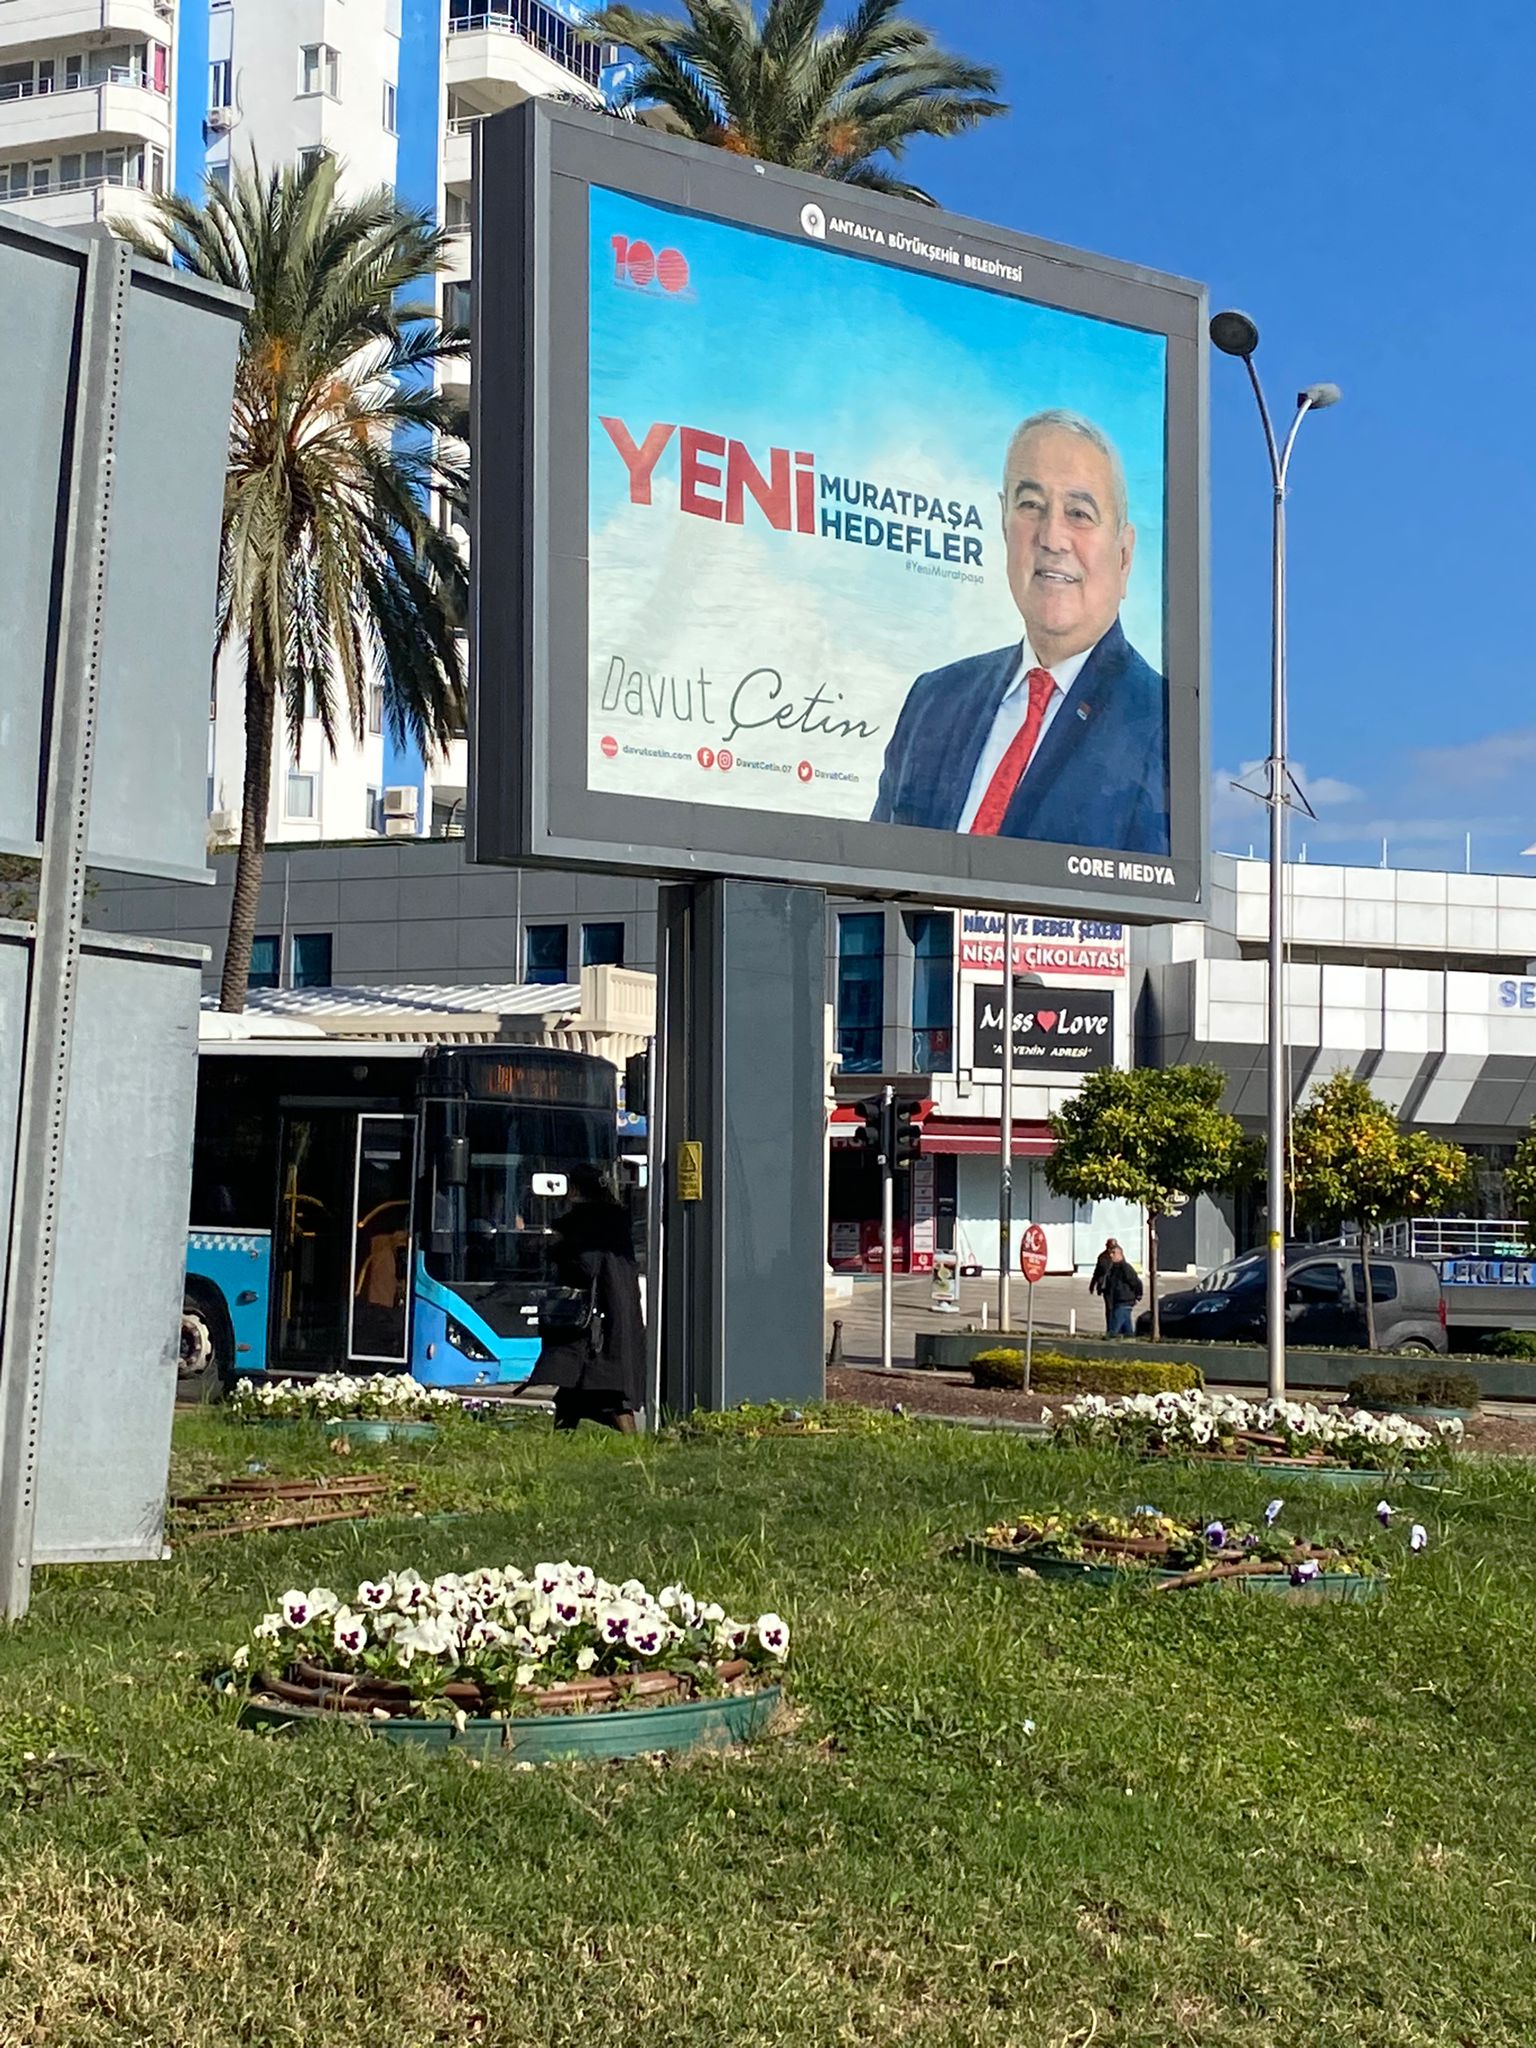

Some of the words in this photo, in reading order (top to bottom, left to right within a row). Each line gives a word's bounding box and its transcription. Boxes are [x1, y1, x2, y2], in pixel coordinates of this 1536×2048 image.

[611, 235, 690, 293] 100
[829, 217, 886, 246] ANTALYA
[888, 231, 960, 266] BÜYÜKŞEHİR
[963, 256, 1023, 282] BELEDİYESİ
[820, 474, 983, 531] MURATPAŞA
[821, 507, 983, 567] HEDEFLER
[601, 655, 716, 725] Davut
[721, 667, 880, 742] Çetin
[1067, 856, 1115, 878] CORE
[1119, 862, 1176, 885] MEDYA
[1033, 919, 1075, 938] BEBEK
[979, 1003, 1036, 1034] Mss
[1057, 1009, 1109, 1035] Love
